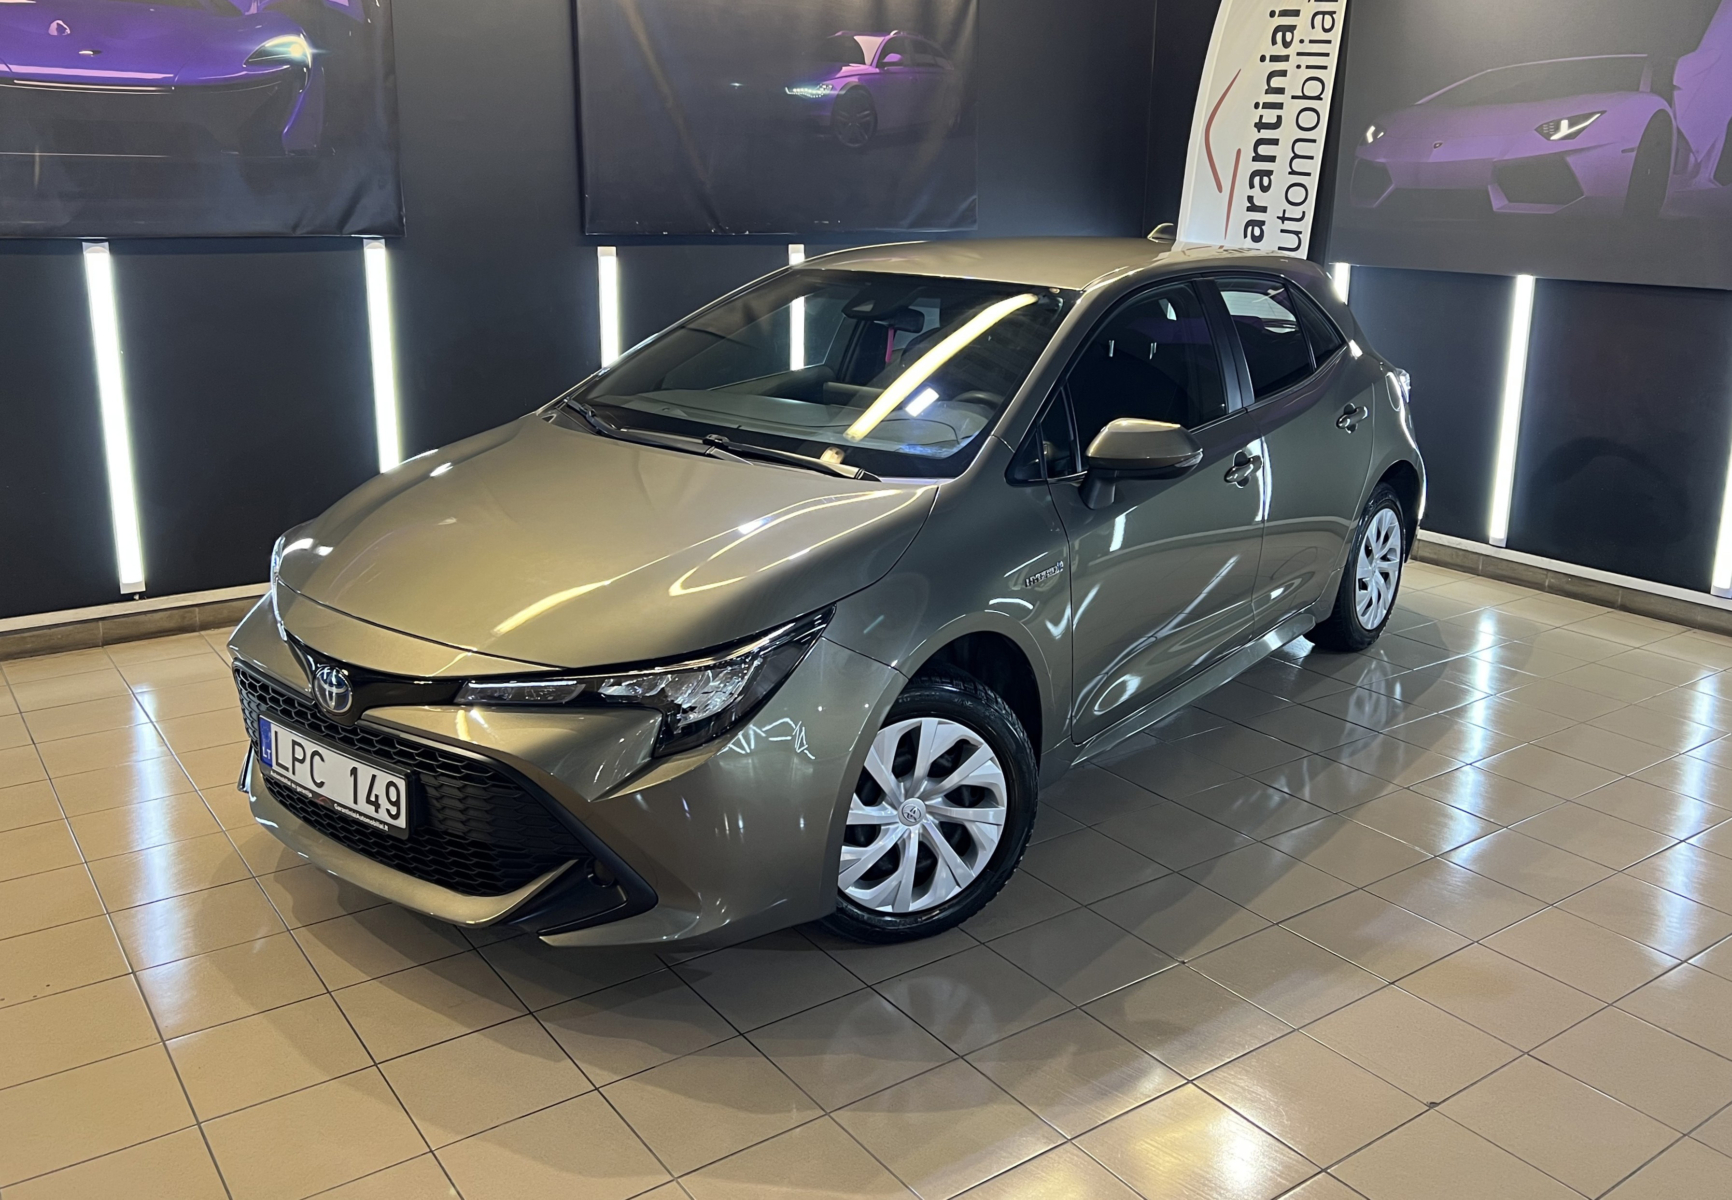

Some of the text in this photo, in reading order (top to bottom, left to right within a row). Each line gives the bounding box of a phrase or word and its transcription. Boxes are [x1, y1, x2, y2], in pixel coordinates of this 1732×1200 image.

[1244, 9, 1302, 243] arantiniai
[1277, 0, 1339, 252] utomobiliai
[262, 746, 271, 759] LT
[274, 730, 325, 789] LPC
[349, 766, 401, 821] 149
